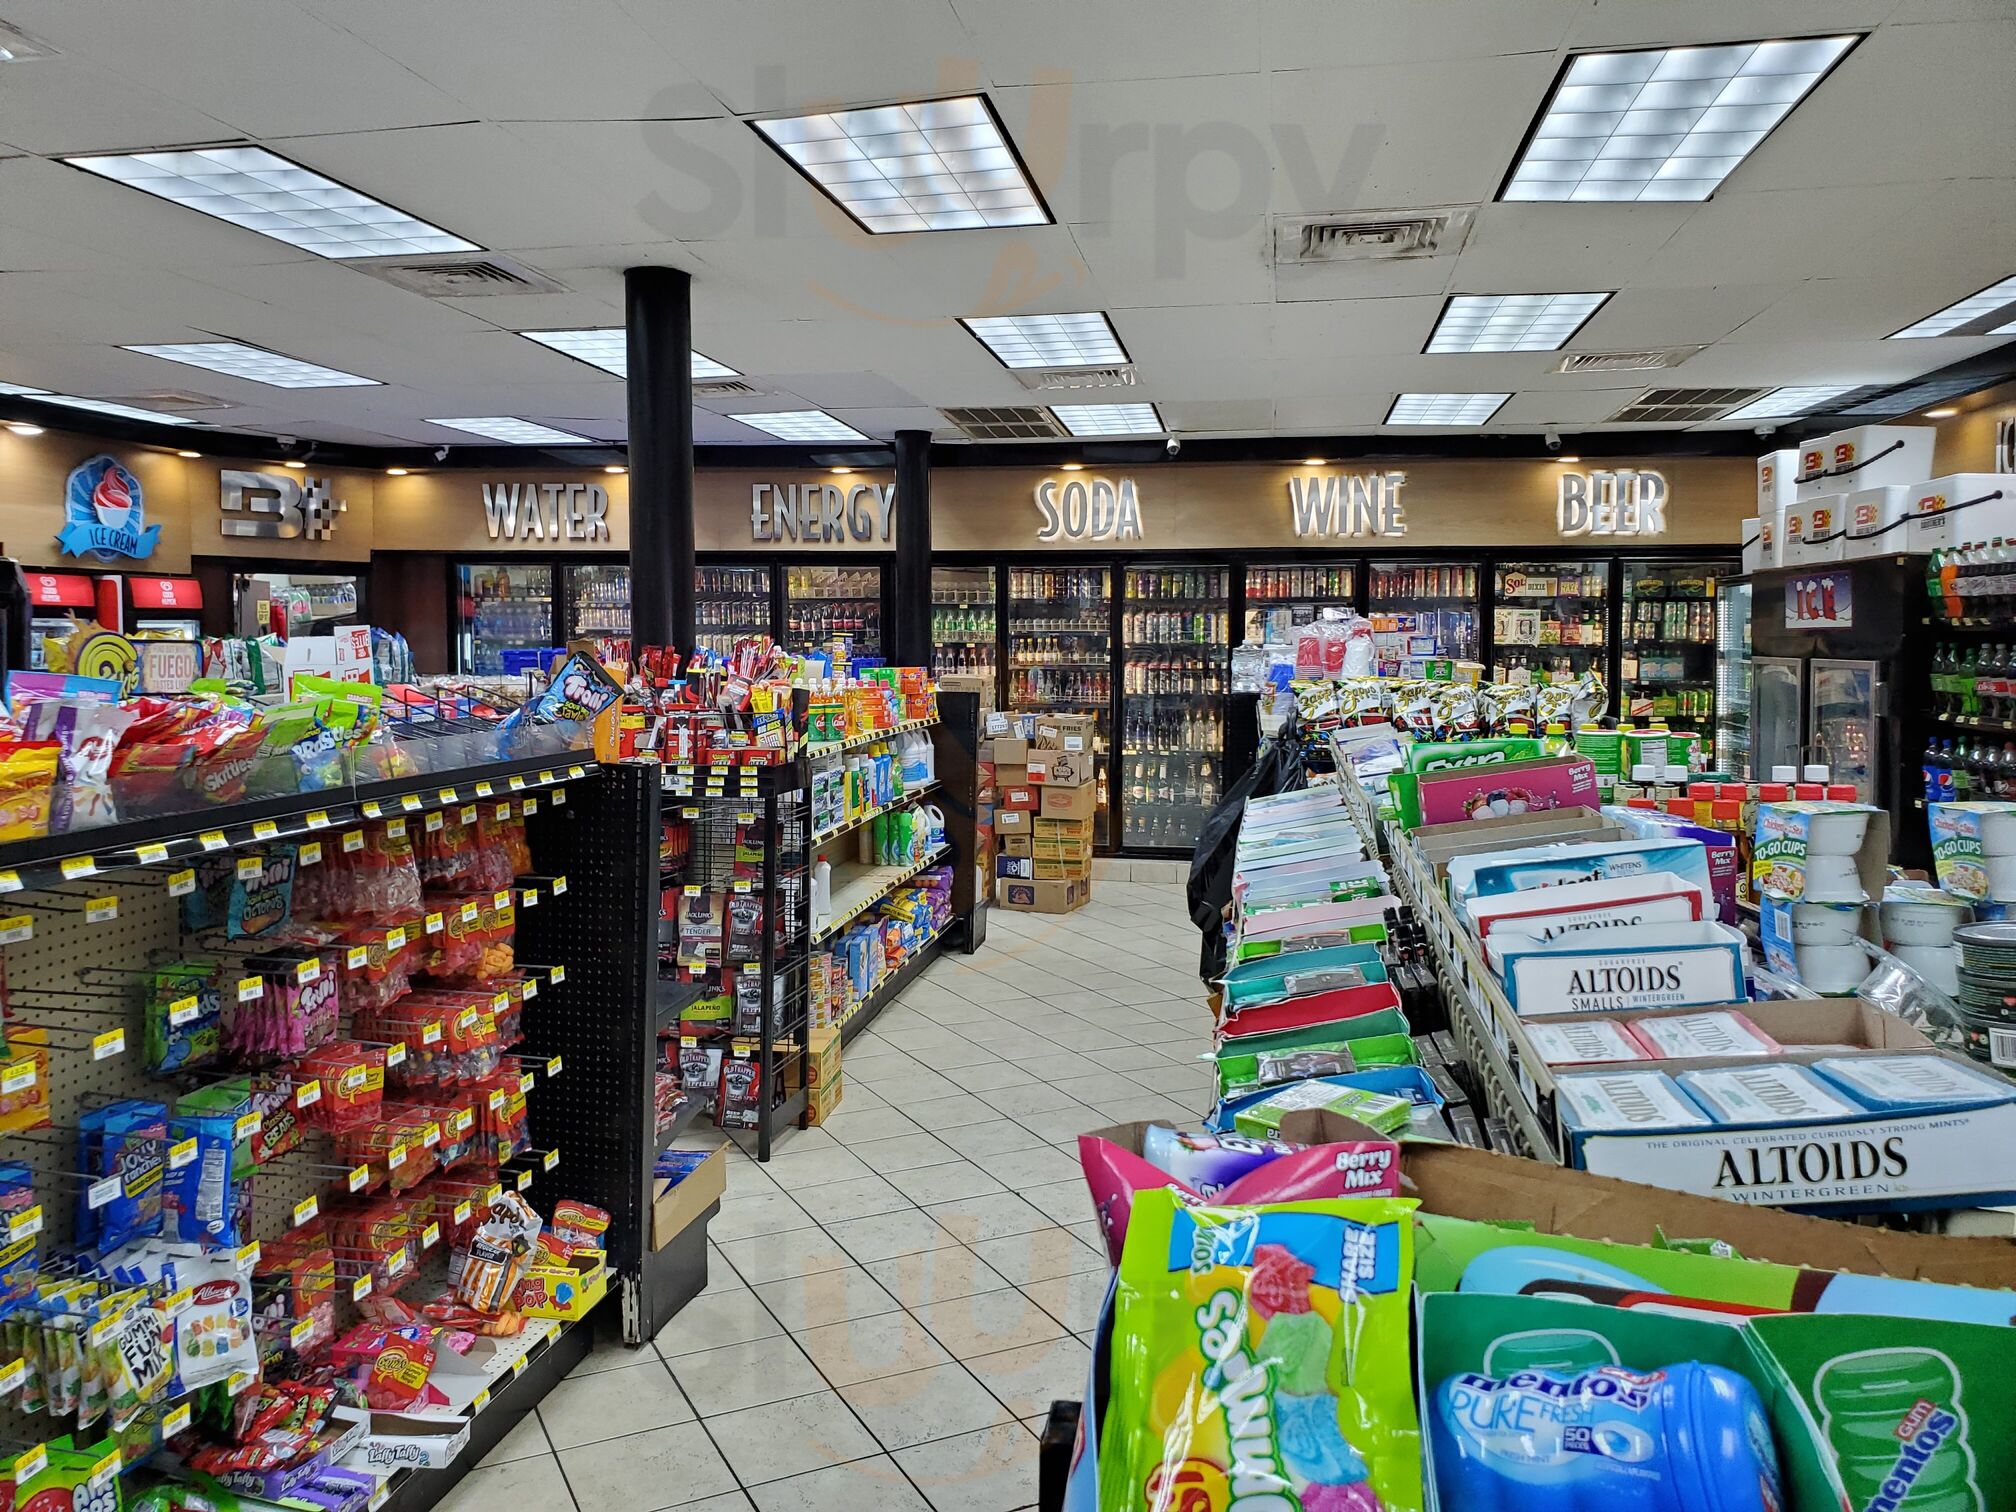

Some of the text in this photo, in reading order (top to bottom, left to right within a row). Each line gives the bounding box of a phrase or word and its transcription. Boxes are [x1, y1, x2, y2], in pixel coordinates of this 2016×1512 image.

[482, 482, 608, 541] WATER
[750, 482, 896, 542] ENERGY
[1035, 479, 1143, 541] SODA
[1291, 471, 1407, 536] WINE
[1560, 470, 1666, 535] BEER
[90, 529, 138, 551] ICE CREAM
[1796, 579, 1836, 621] ICE
[149, 654, 193, 679] FUEGO
[564, 674, 610, 712] Trolli
[203, 757, 255, 792] Skittles
[1568, 764, 1590, 776] Berry
[1609, 861, 1642, 872] WHITENS
[1711, 850, 1734, 860] Berry
[1754, 841, 1806, 861] TO-GO CUPS
[1934, 840, 1982, 860] TO-GO CUPS
[242, 896, 284, 921] OCTOPUS
[686, 928, 711, 936] TENDER
[1566, 964, 1681, 996] ALTOIDS
[1572, 994, 1686, 1012] SMALLS WINTERGREEN
[1558, 1024, 1614, 1059] ALTOIDS
[1675, 1014, 1745, 1053] ALTOIDS
[687, 1080, 714, 1088] EPPERED
[1596, 1078, 1667, 1123] ALTOIDS
[1734, 1072, 1818, 1116] ALTOIDS
[264, 1112, 296, 1147] BEARS
[1646, 1140, 1669, 1150] THE
[1672, 1136, 1728, 1149] ORIGINAL
[1732, 1132, 1807, 1145] CELEBRATED
[1811, 1126, 1876, 1140] CURIOUSLY
[1878, 1122, 1926, 1135] STRONG
[1335, 1150, 1392, 1172] Berry
[1712, 1136, 1909, 1188] ALTOIDS
[1345, 1168, 1383, 1189] Mix
[1731, 1182, 1892, 1202] WINTERGREEN
[1358, 1229, 1377, 1280] SIZE
[514, 1291, 548, 1314] POP
[118, 1312, 160, 1351] GUMMI
[1460, 1372, 1652, 1410] mentos
[1451, 1390, 1594, 1434] PURE FRESH
[1565, 1428, 1590, 1442] 50
[368, 1444, 421, 1466] Laffy Taffy
[1864, 1410, 1958, 1512] mentos
